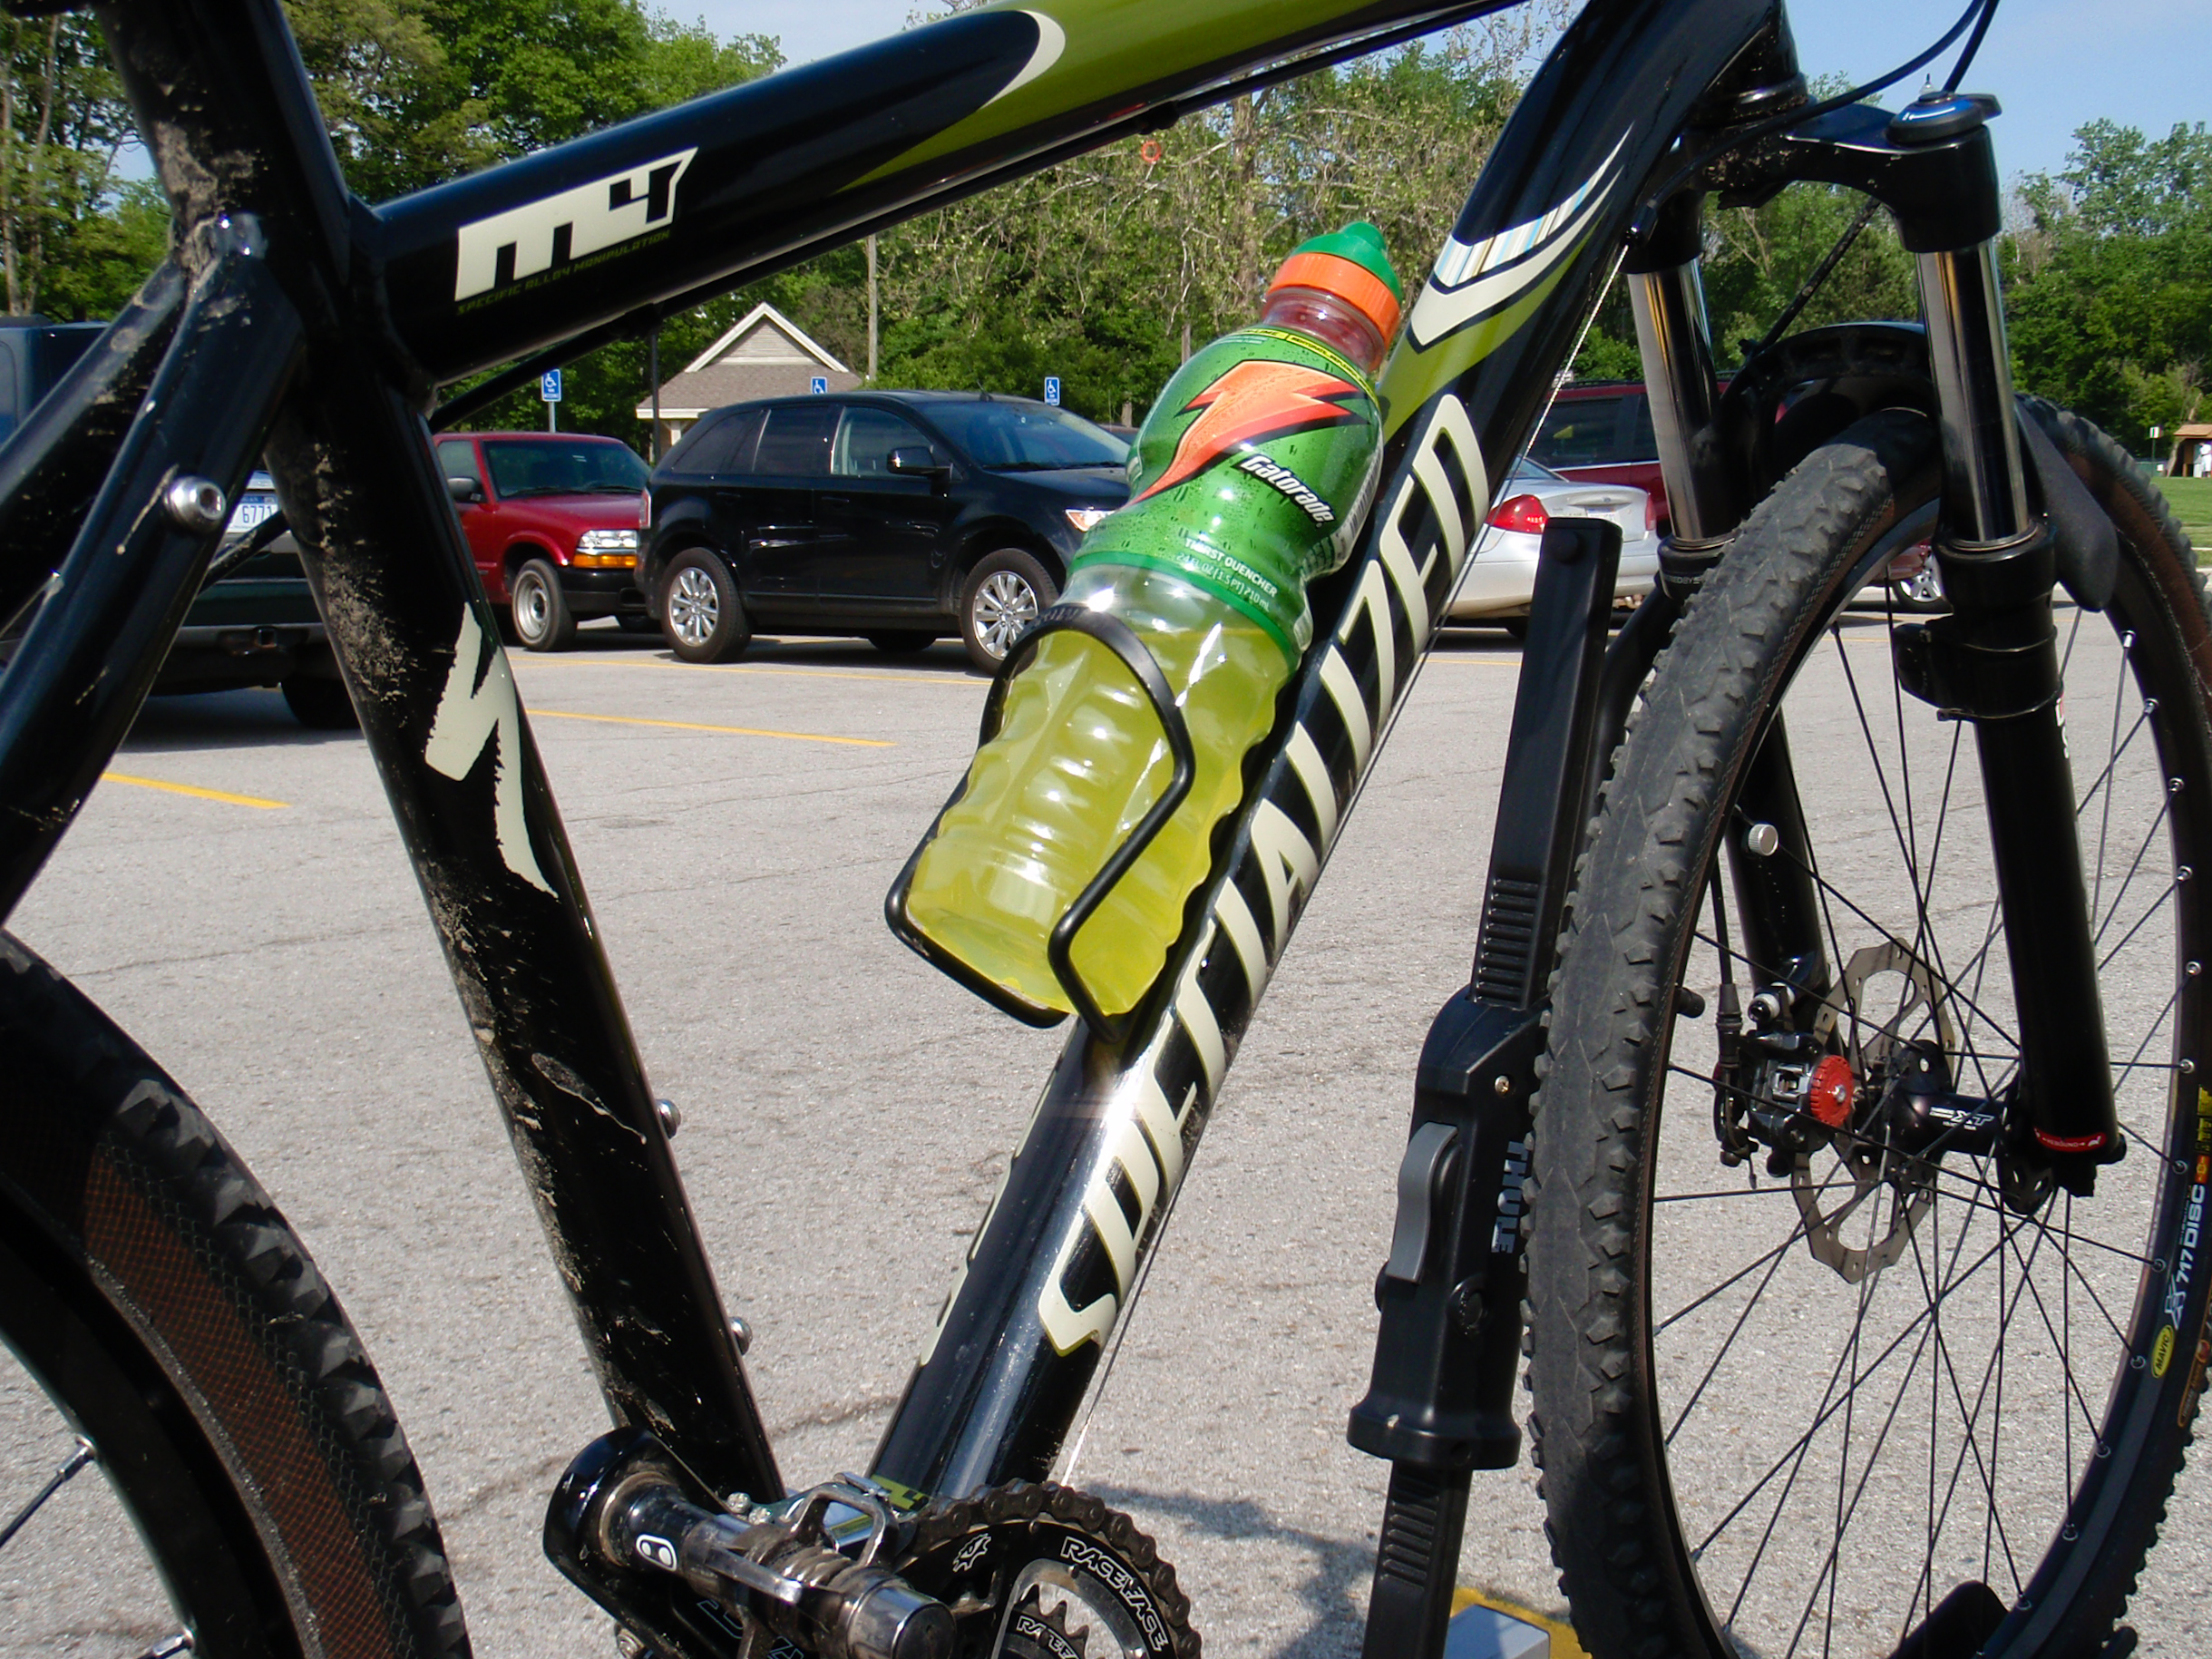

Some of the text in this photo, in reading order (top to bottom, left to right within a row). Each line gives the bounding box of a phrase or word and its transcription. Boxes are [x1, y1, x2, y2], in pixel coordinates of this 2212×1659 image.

[457, 283, 521, 316] SPECIFIC
[524, 268, 570, 291] ALLOY
[1240, 454, 1335, 522] Gatorade
[1223, 556, 1278, 598] QUENCHER
[1491, 1140, 1529, 1254] THULE
[2183, 1184, 2206, 1249] DISC
[2176, 1248, 2194, 1283] 717
[2155, 1333, 2171, 1371] MAVIC
